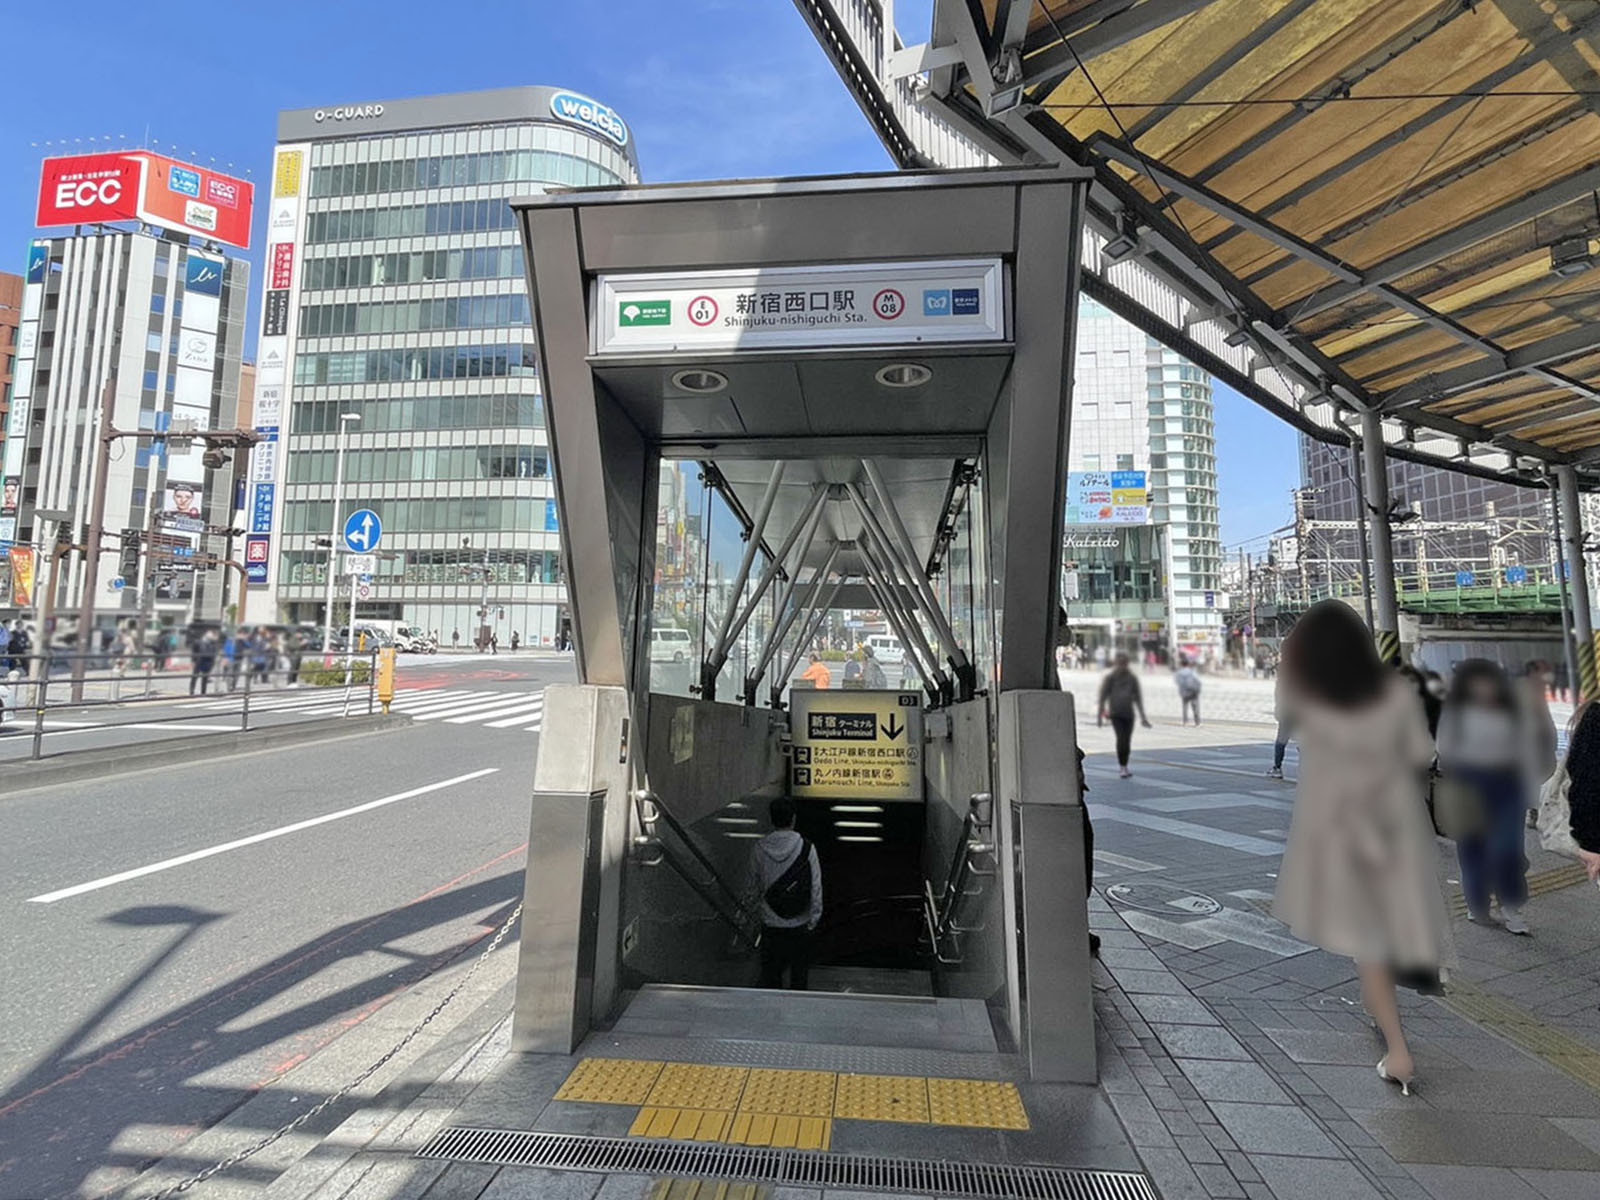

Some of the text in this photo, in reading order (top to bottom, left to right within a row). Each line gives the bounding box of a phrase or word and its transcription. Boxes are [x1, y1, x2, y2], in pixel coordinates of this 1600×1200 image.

[314, 104, 384, 121] O-GUARD
[560, 98, 623, 140] welcia
[55, 178, 122, 208] ECC
[736, 290, 855, 314] 新宿西口駅
[883, 294, 894, 302] M
[700, 300, 706, 310] E
[881, 303, 897, 314] 08
[695, 310, 709, 320] 01
[724, 312, 867, 328] Shinjuku-nishiguchi Sta.
[812, 728, 874, 738] Shinjuku Terminal
[814, 768, 881, 778] 丸ノ内線新宿駅
